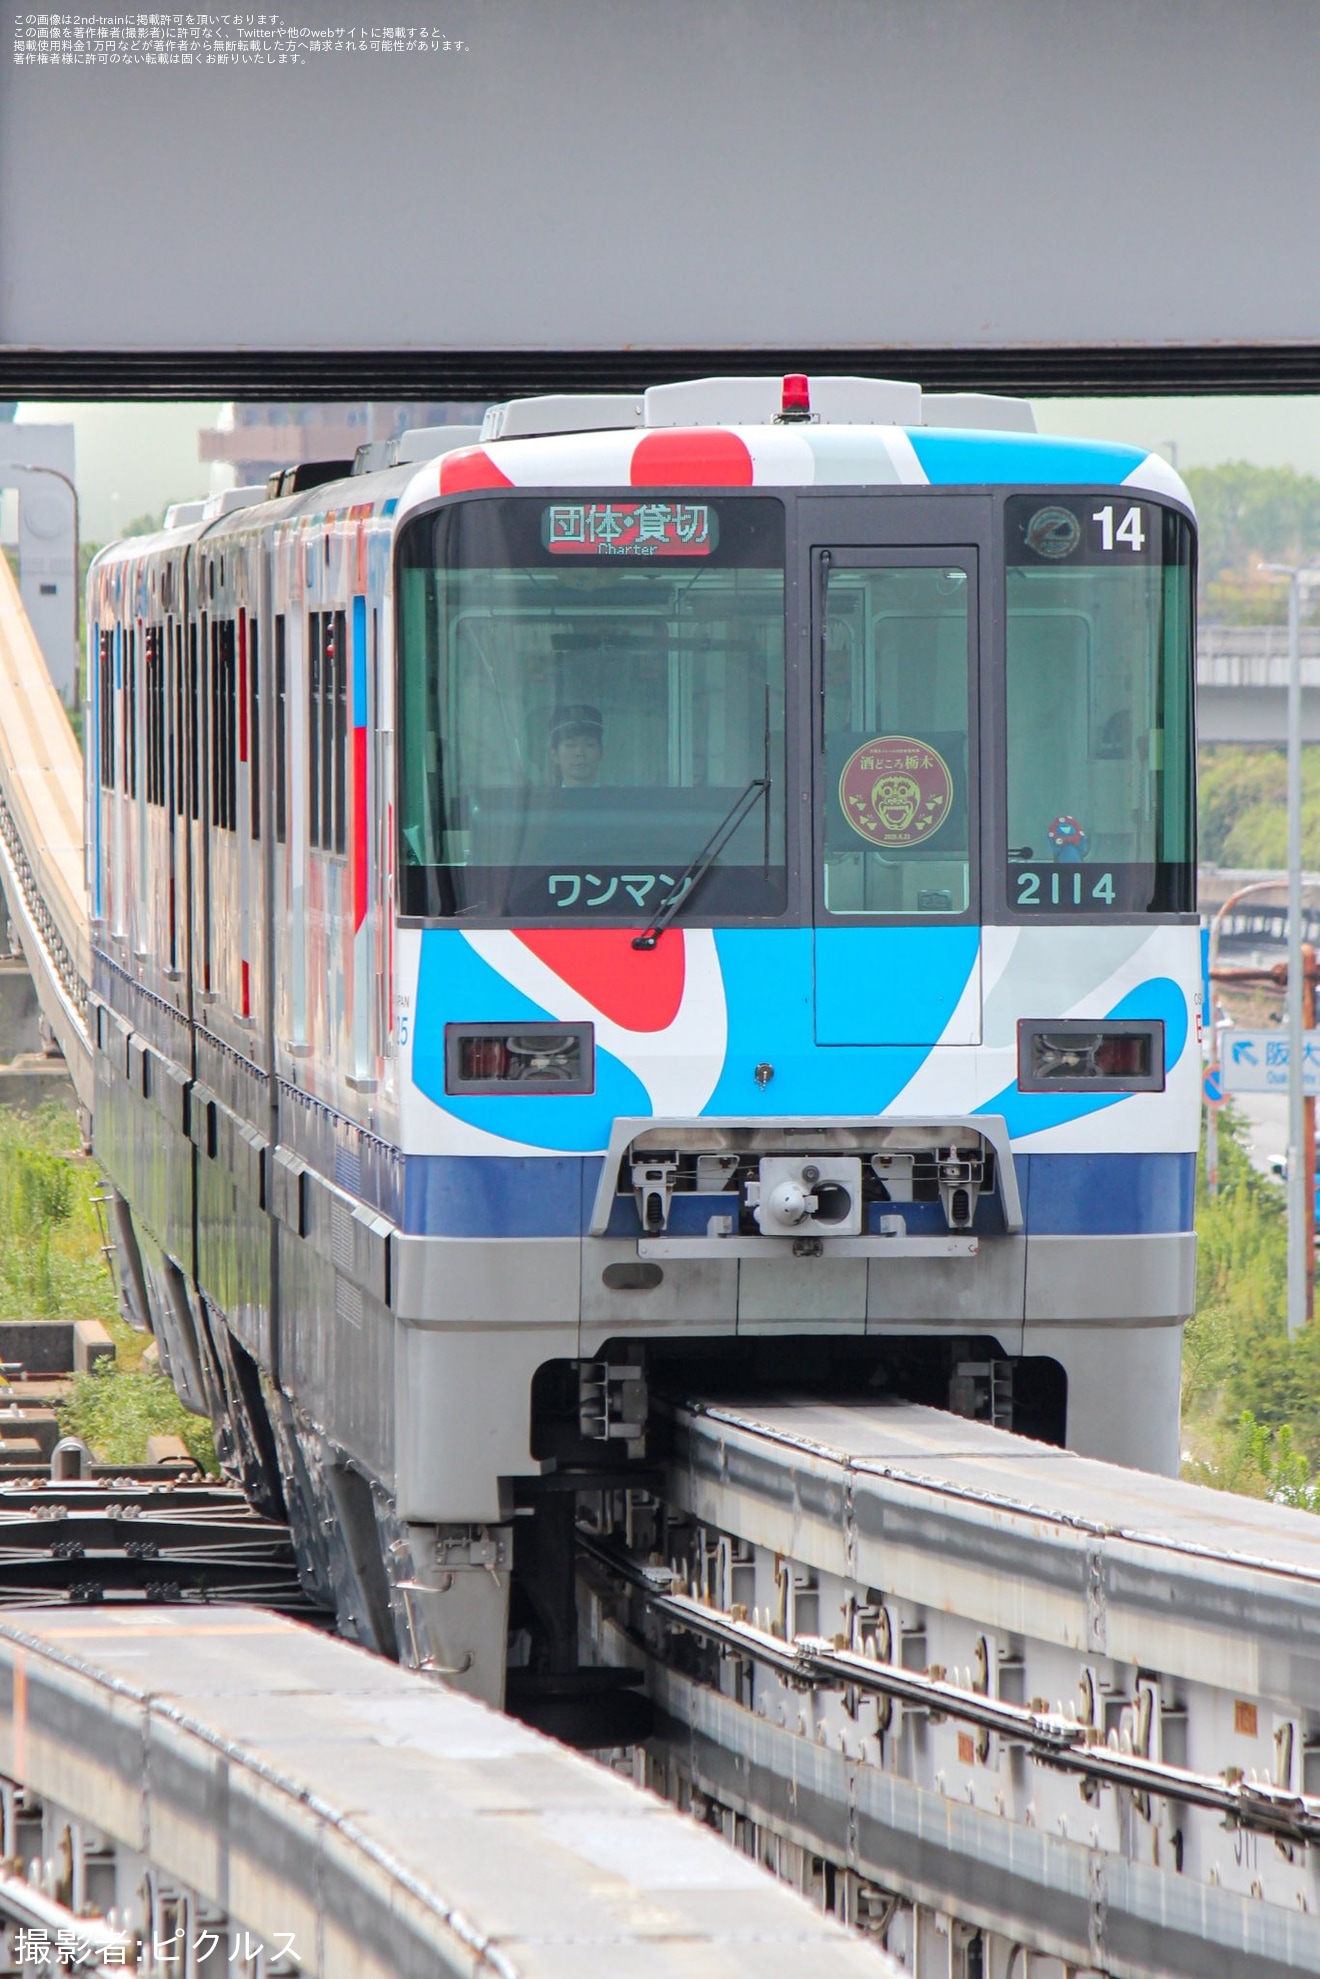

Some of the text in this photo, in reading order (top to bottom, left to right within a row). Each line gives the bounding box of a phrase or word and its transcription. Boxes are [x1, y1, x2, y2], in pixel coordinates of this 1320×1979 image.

[1092, 505, 1146, 551] 14
[860, 755, 934, 770] 酒どころ栃木
[548, 873, 693, 907] ワンマン
[1017, 872, 1116, 905] 2114
